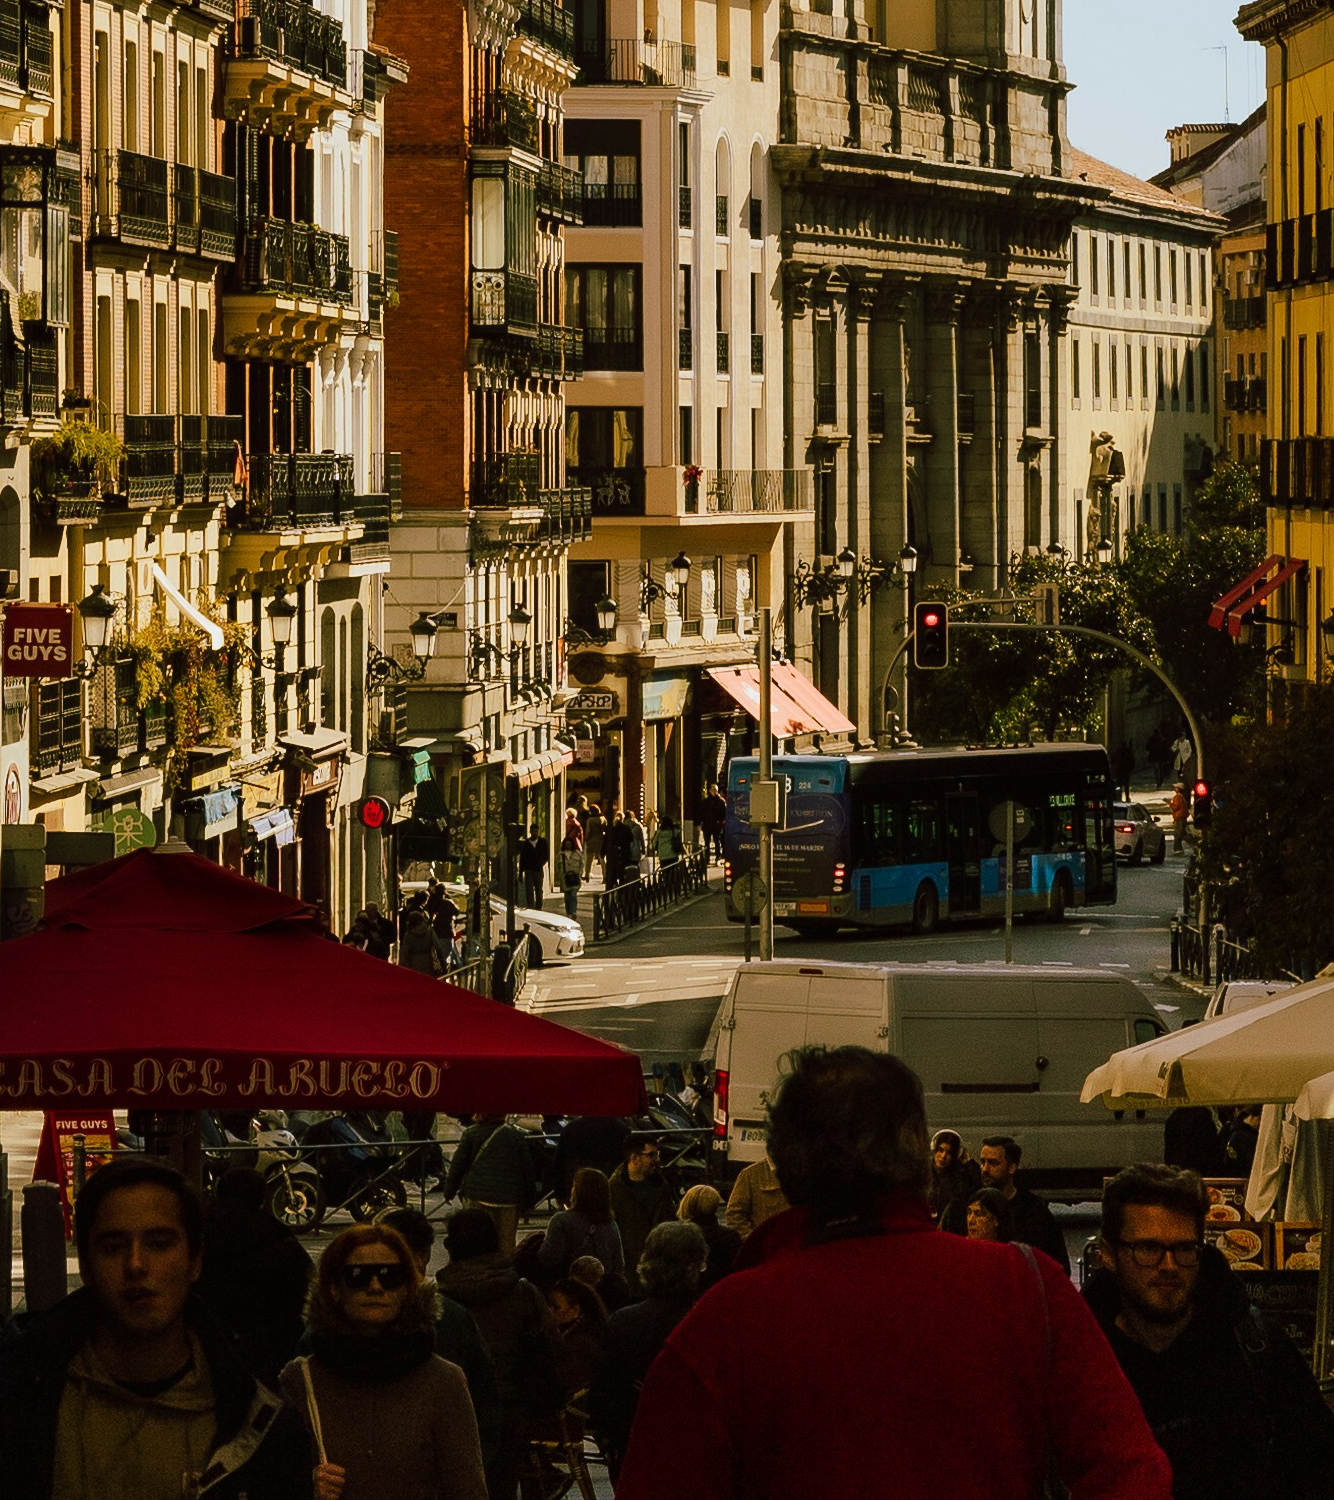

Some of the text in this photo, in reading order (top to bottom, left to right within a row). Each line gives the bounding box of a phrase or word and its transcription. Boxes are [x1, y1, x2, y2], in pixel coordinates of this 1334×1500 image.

[13, 627, 62, 644] FIVE
[7, 644, 67, 661] GUYS
[126, 1056, 227, 1096] DEL
[237, 1057, 442, 1098] ABUELO
[55, 1119, 108, 1130] FIVE GUYS
